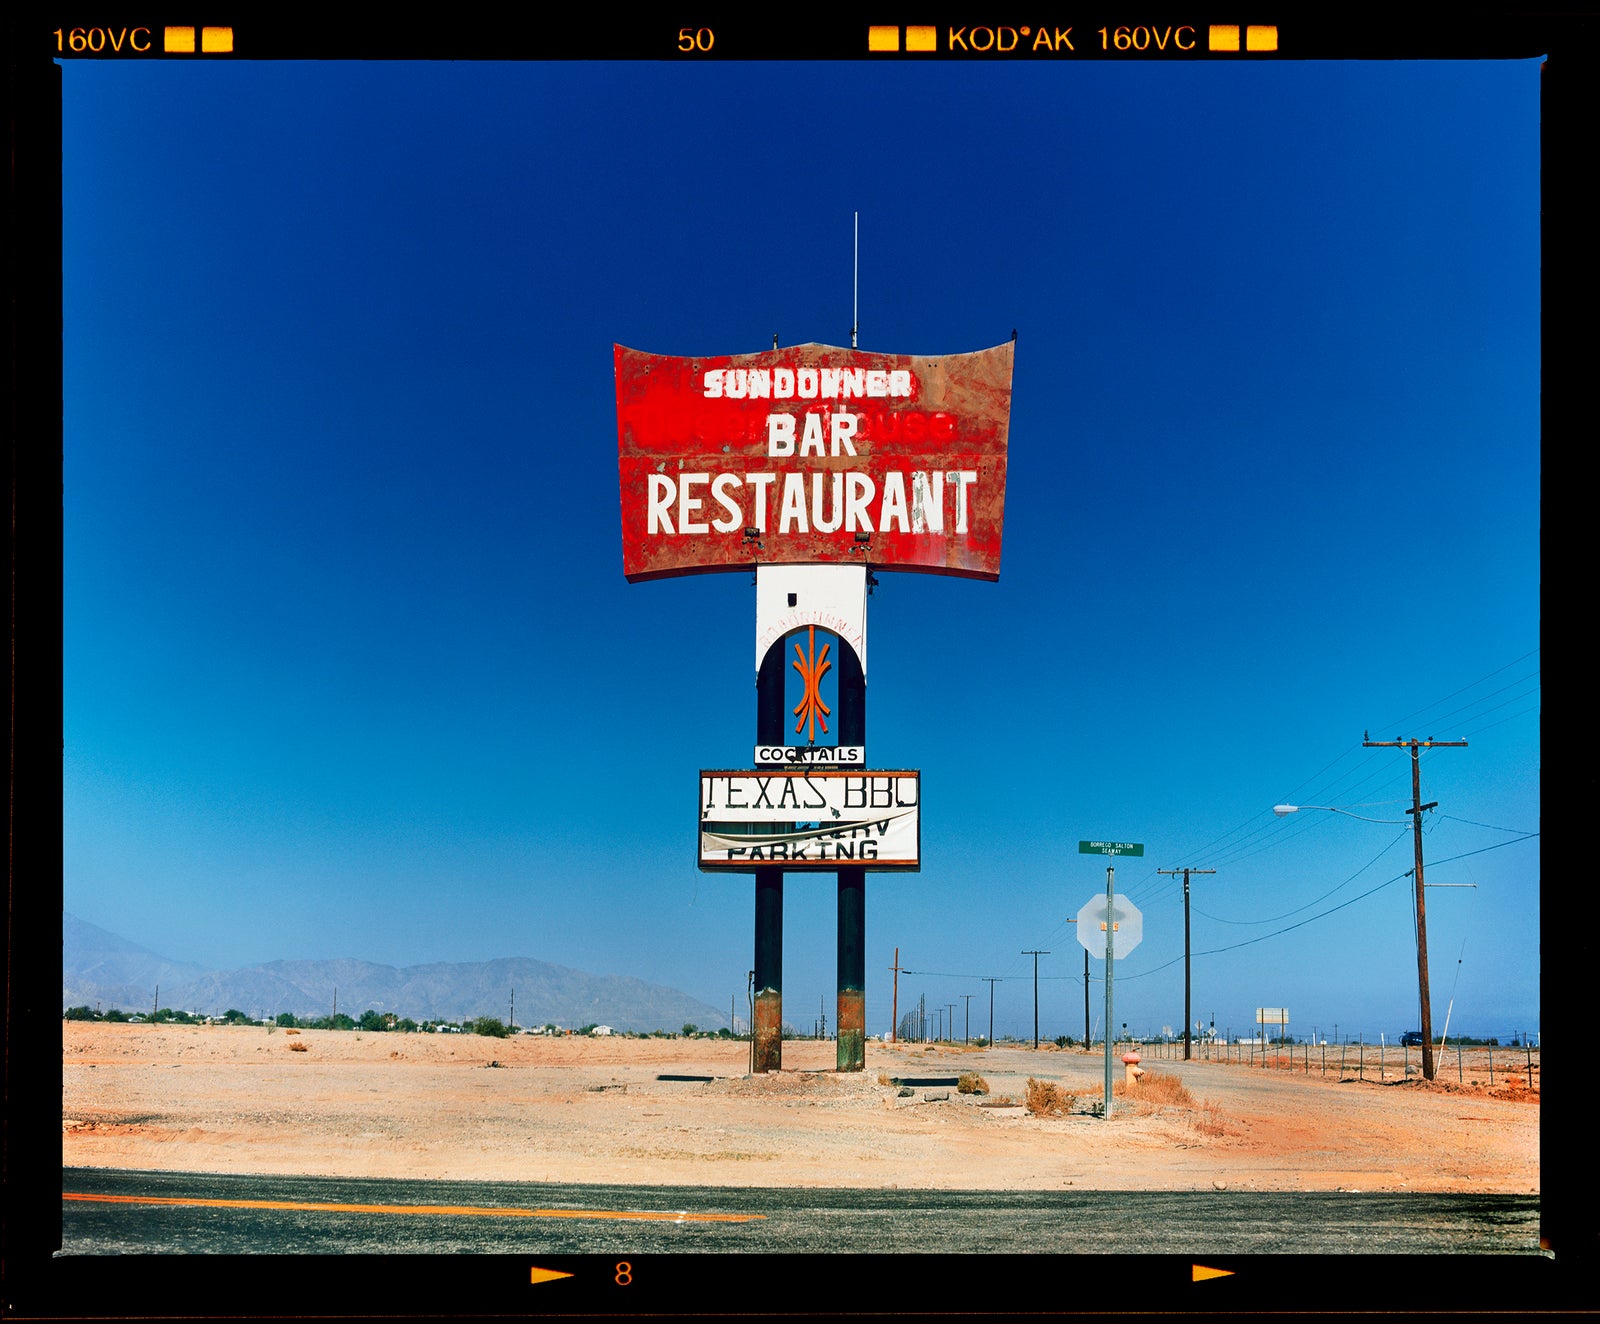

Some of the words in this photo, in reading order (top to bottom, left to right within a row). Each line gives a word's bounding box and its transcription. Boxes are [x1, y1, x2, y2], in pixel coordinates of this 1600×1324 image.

[53, 28, 152, 52] 160VC
[678, 28, 715, 52] 50
[1097, 26, 1196, 51] 160VC
[703, 368, 911, 399] SUNDOWNER
[768, 412, 858, 457] BAR
[647, 471, 977, 535] RESTAURANT
[703, 777, 827, 809] TEXAS
[614, 1261, 633, 1286] 8
